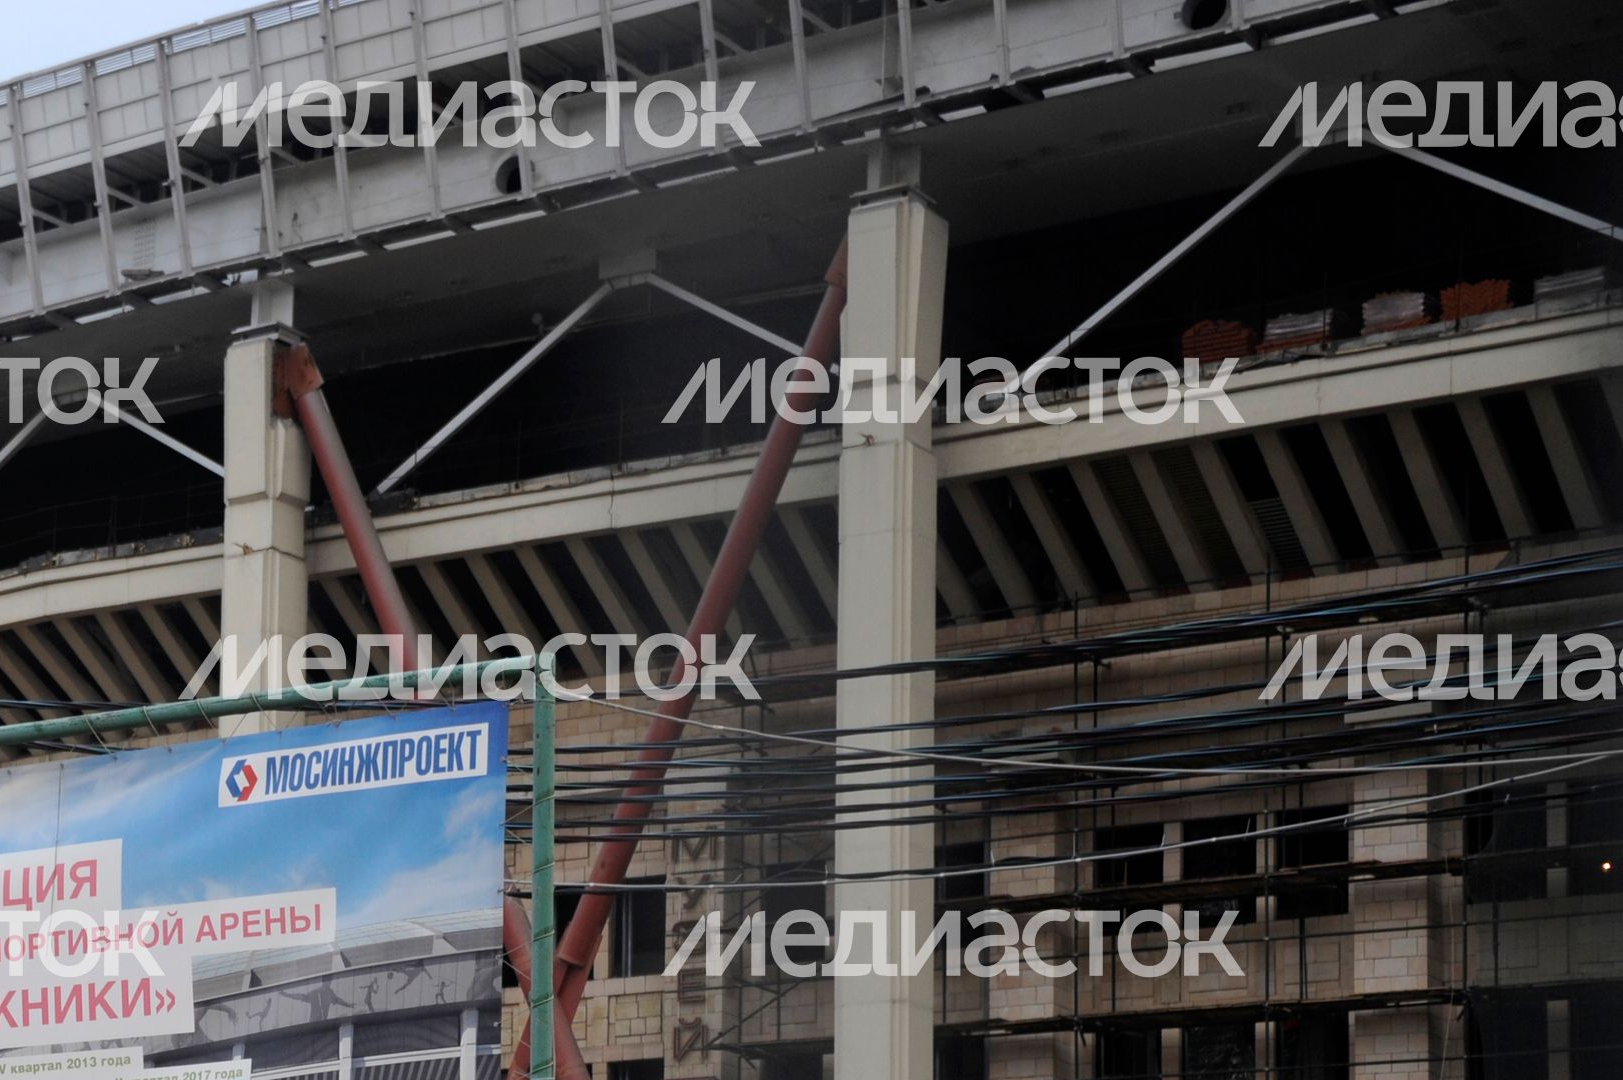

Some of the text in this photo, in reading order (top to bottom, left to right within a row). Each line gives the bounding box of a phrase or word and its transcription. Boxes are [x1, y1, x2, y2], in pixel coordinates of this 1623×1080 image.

[265, 729, 482, 795] МОСИНЖПРОЕКТ
[196, 904, 322, 943] АРЕНЫ
[11, 1062, 62, 1077] квартал
[67, 1057, 97, 1069] 2013
[101, 1054, 131, 1069] года
